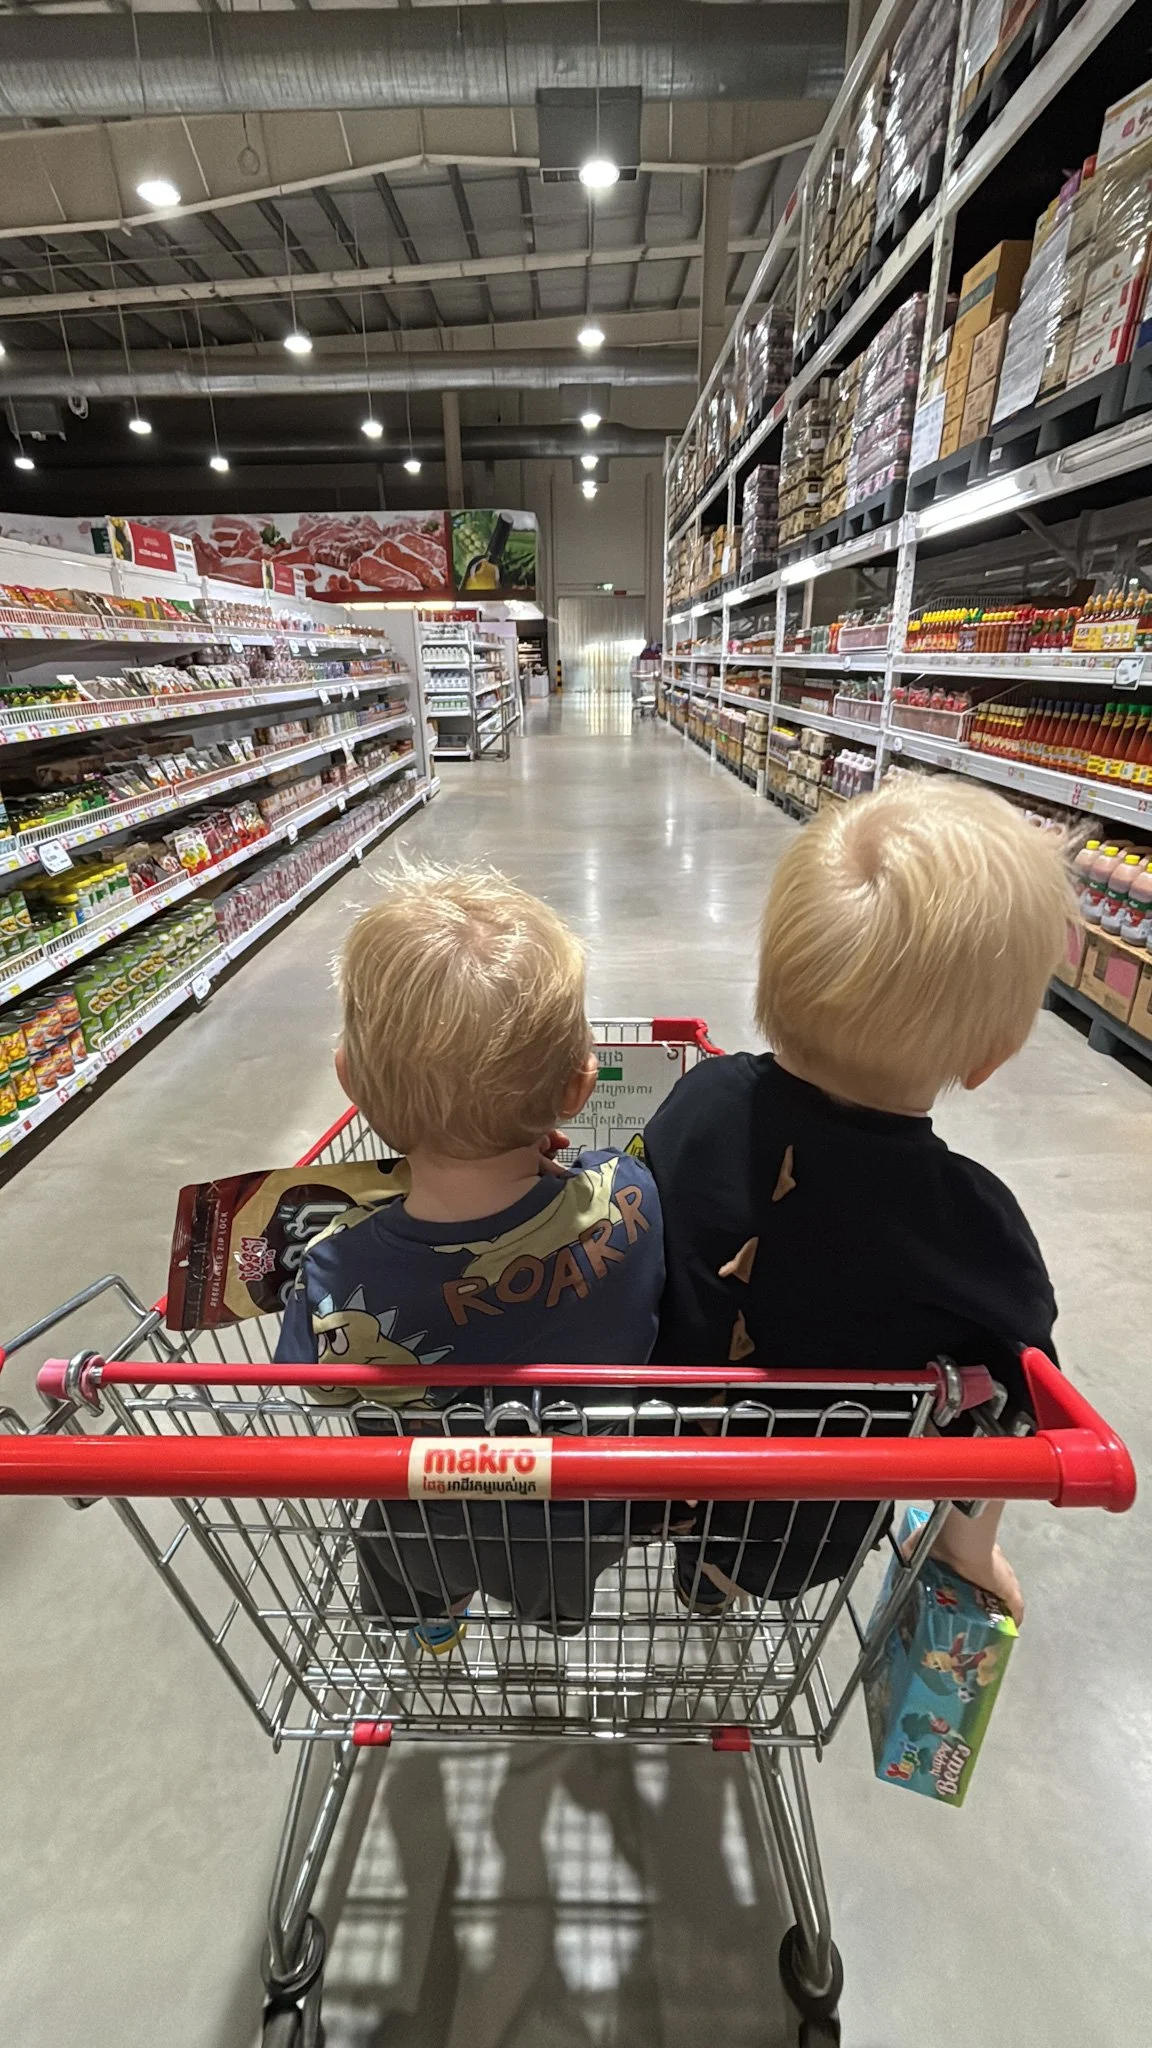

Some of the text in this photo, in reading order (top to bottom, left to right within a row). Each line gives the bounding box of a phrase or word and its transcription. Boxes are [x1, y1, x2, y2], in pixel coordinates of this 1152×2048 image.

[210, 1210, 228, 1306] RESEALABLE ZIP LOCK
[442, 1184, 650, 1326] ROARR
[424, 1443, 537, 1474] makro
[936, 1744, 971, 1795] Bears
